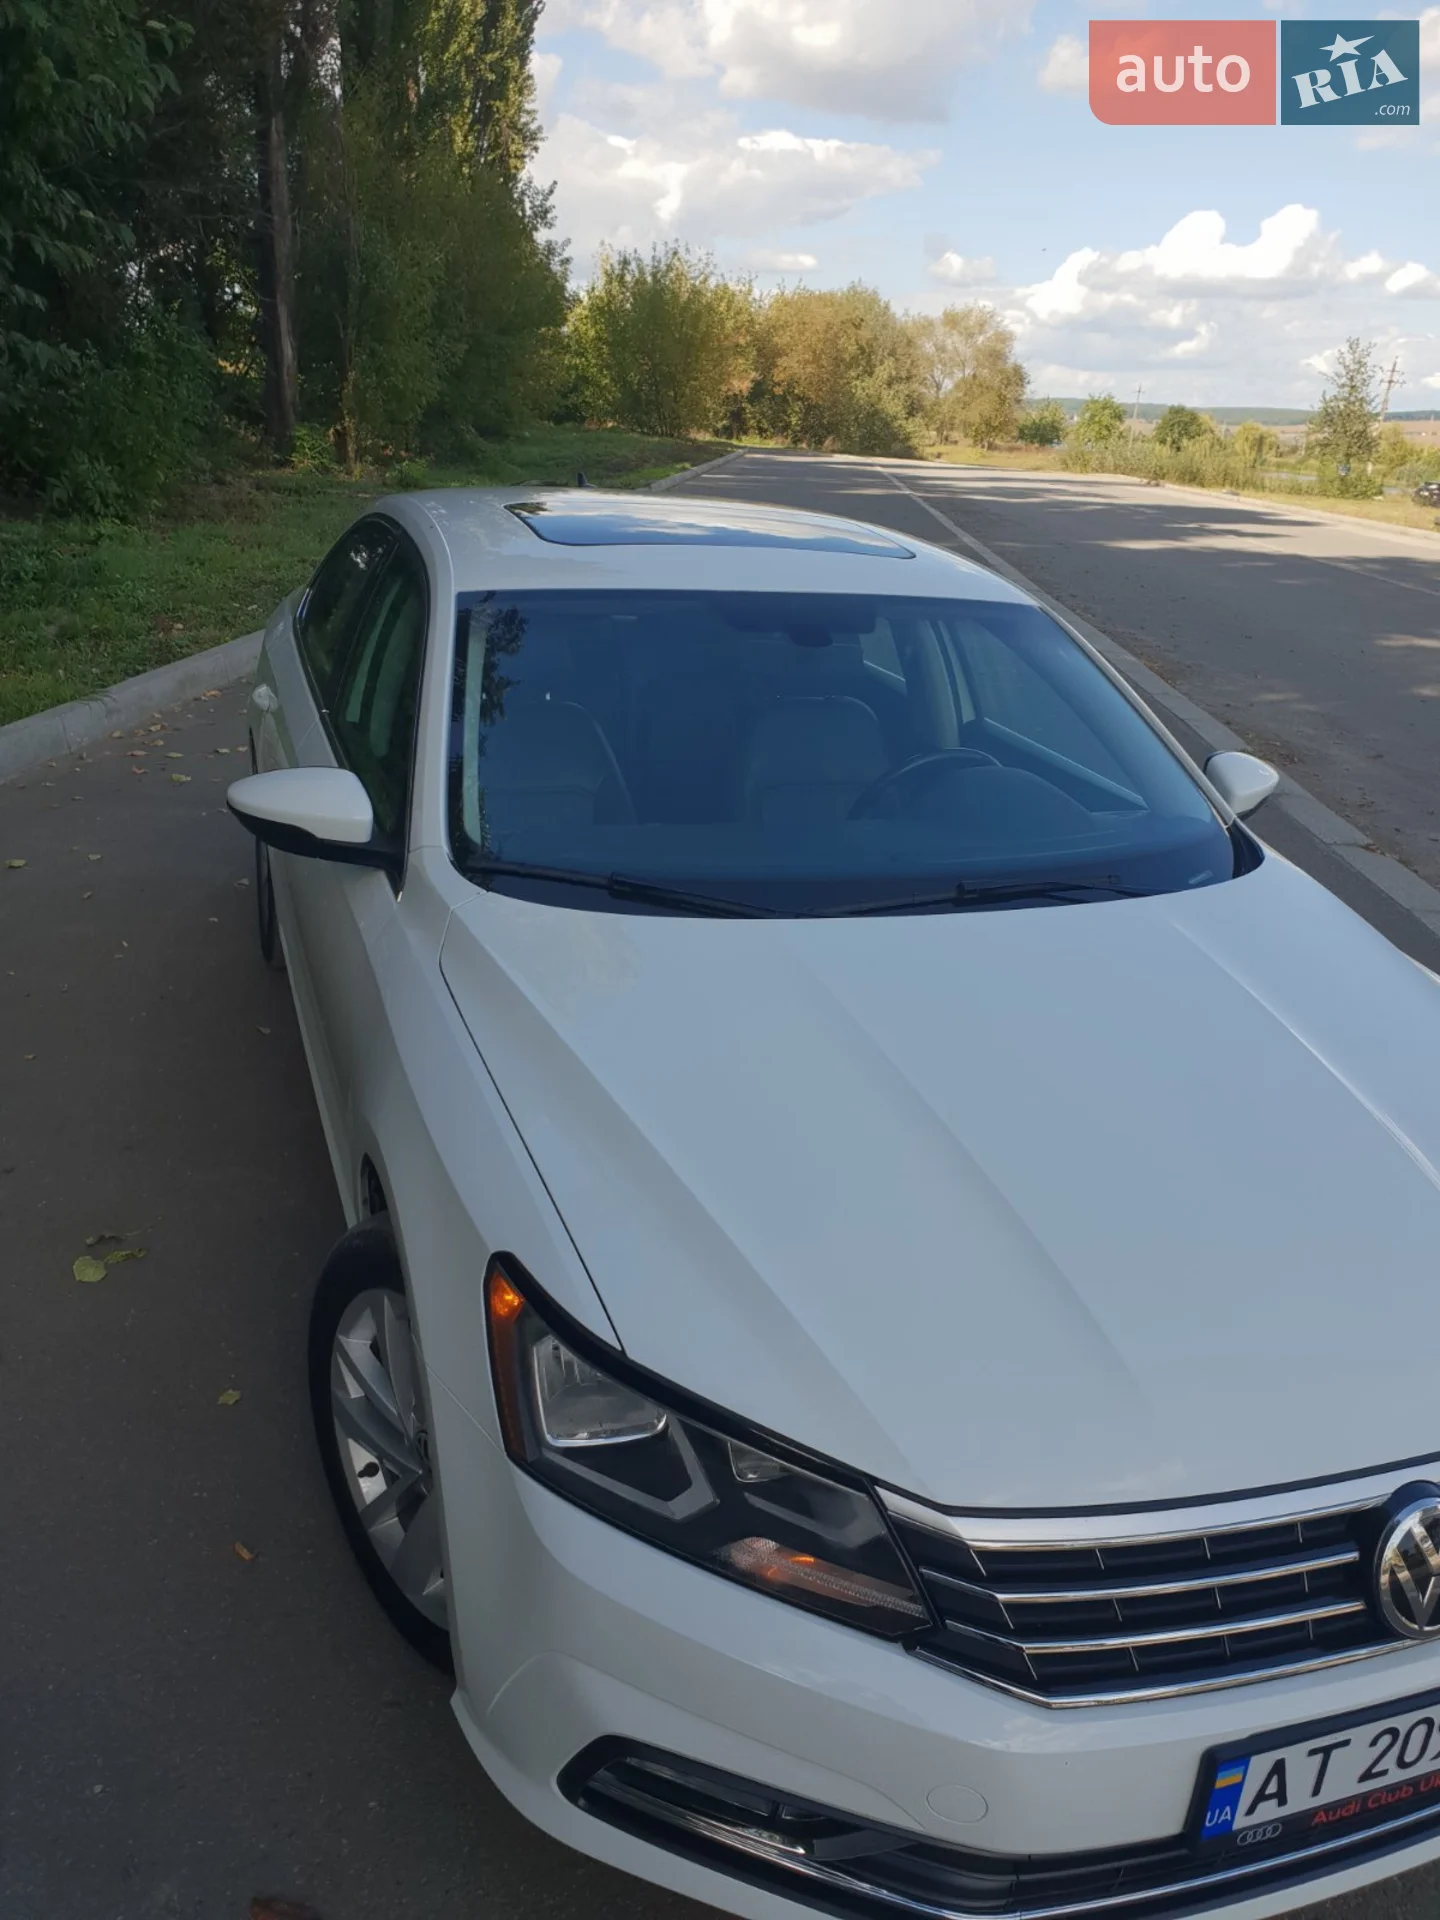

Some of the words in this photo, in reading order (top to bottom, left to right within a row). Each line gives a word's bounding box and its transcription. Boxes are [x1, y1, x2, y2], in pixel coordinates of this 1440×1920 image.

[1243, 1739, 1352, 1817] AT
[1204, 1805, 1232, 1827] UA
[1311, 1801, 1361, 1827] Audi
[1367, 1785, 1414, 1809] Club
